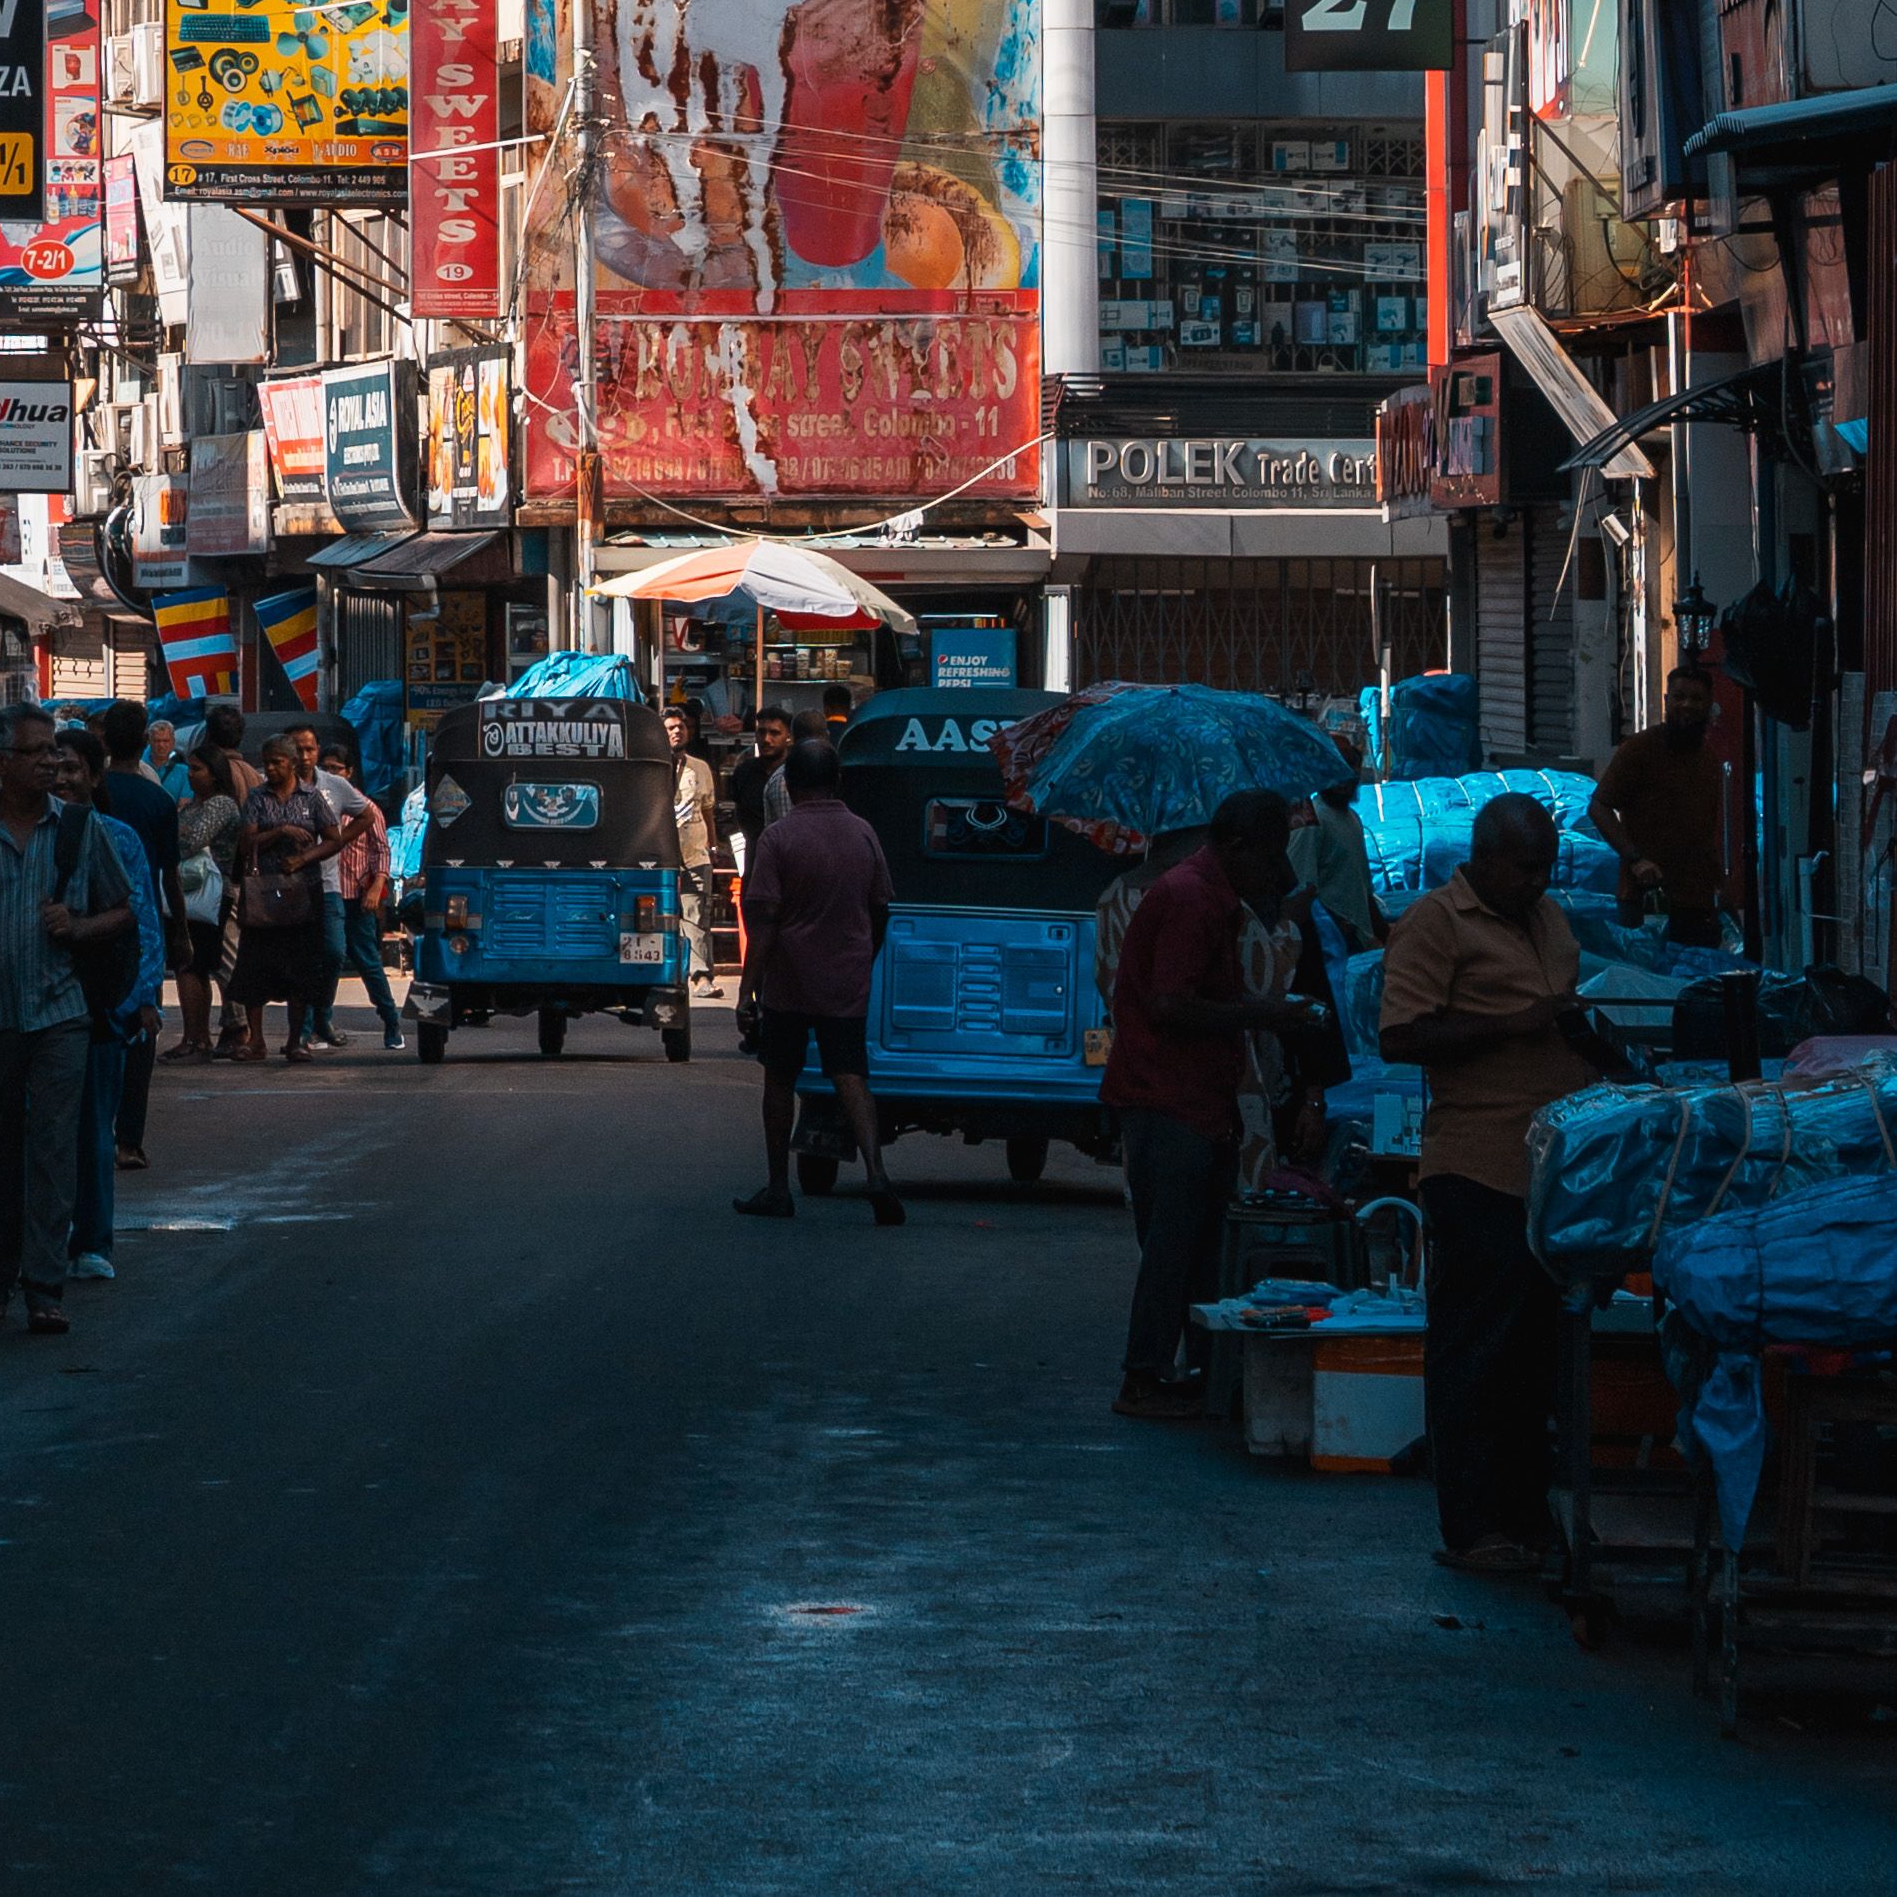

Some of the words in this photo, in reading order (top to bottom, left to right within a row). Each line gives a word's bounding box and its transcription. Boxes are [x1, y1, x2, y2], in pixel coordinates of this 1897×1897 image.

[423, 63, 488, 244] SWEETS
[172, 167, 192, 182] 17
[220, 172, 238, 184] First
[239, 173, 261, 184] Cross
[26, 249, 66, 270] 7-2/1
[443, 266, 465, 279] 19
[1087, 440, 1246, 486] POLEK
[1257, 450, 1320, 486] Trade
[1135, 486, 1185, 499] Maliban
[1187, 486, 1227, 499] Street
[1231, 486, 1288, 499] Colombo
[1311, 486, 1329, 499] Sri
[950, 655, 989, 666] ENJOY
[937, 667, 1011, 678] REFRESHING
[507, 743, 605, 757] BEST
